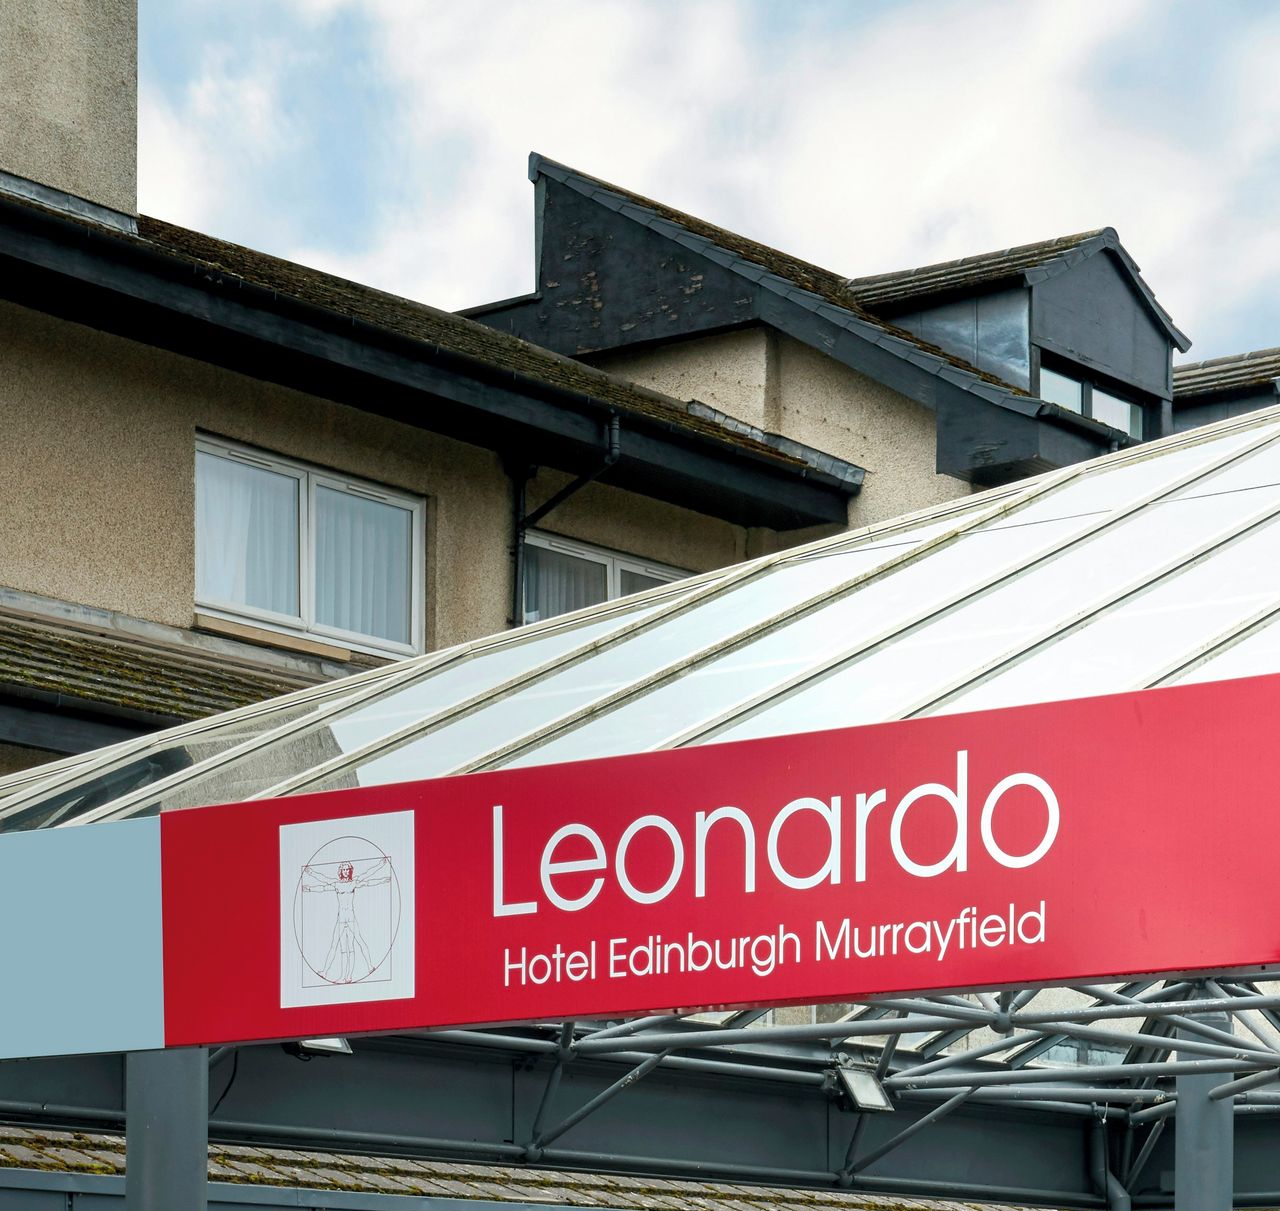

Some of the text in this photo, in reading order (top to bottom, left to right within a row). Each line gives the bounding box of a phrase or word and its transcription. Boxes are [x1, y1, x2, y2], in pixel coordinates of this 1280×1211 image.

[492, 749, 1061, 918] Leonardo
[504, 900, 1046, 987] Hotel Edinburgh Murrayfield
